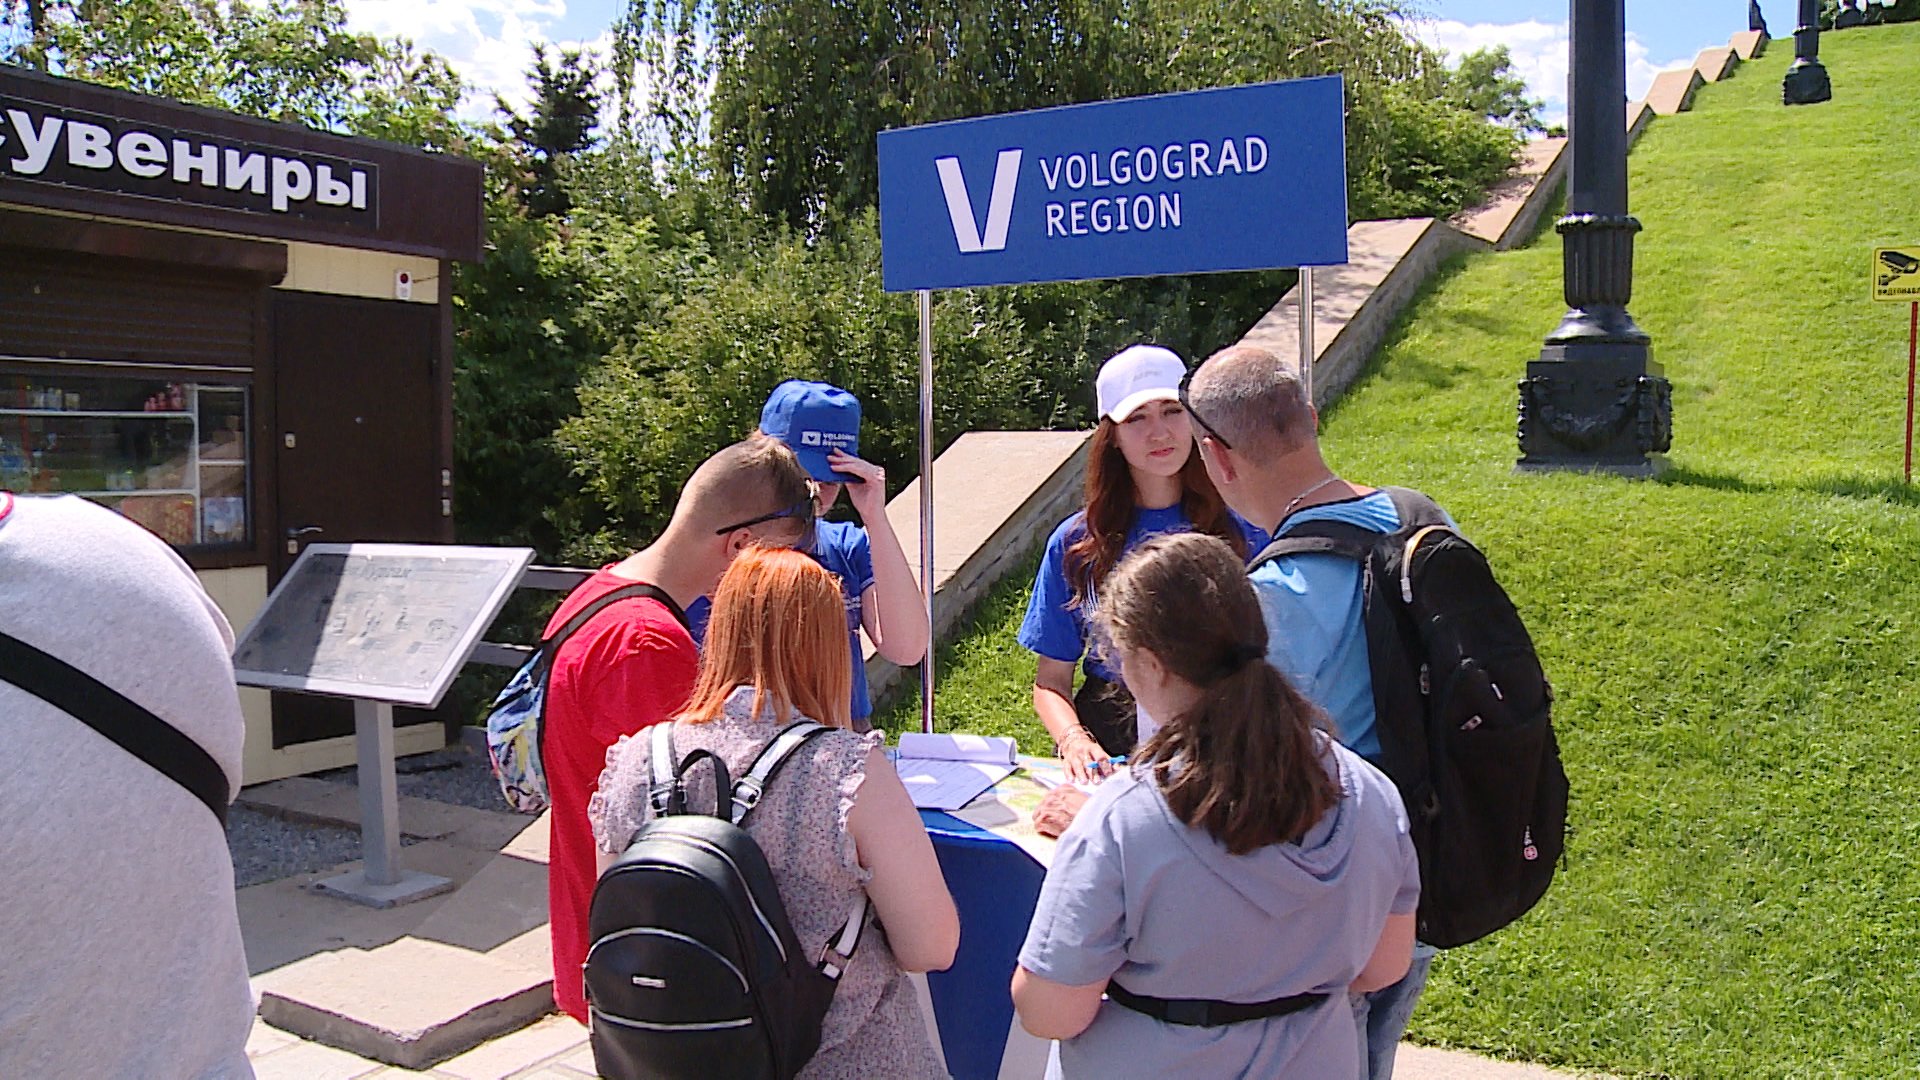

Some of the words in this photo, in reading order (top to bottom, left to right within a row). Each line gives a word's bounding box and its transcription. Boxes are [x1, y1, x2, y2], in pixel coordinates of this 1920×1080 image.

[0, 109, 366, 212] увениры
[1039, 136, 1269, 190] VOLGOGRAD
[935, 149, 1022, 253] V
[1046, 193, 1182, 237] REGION
